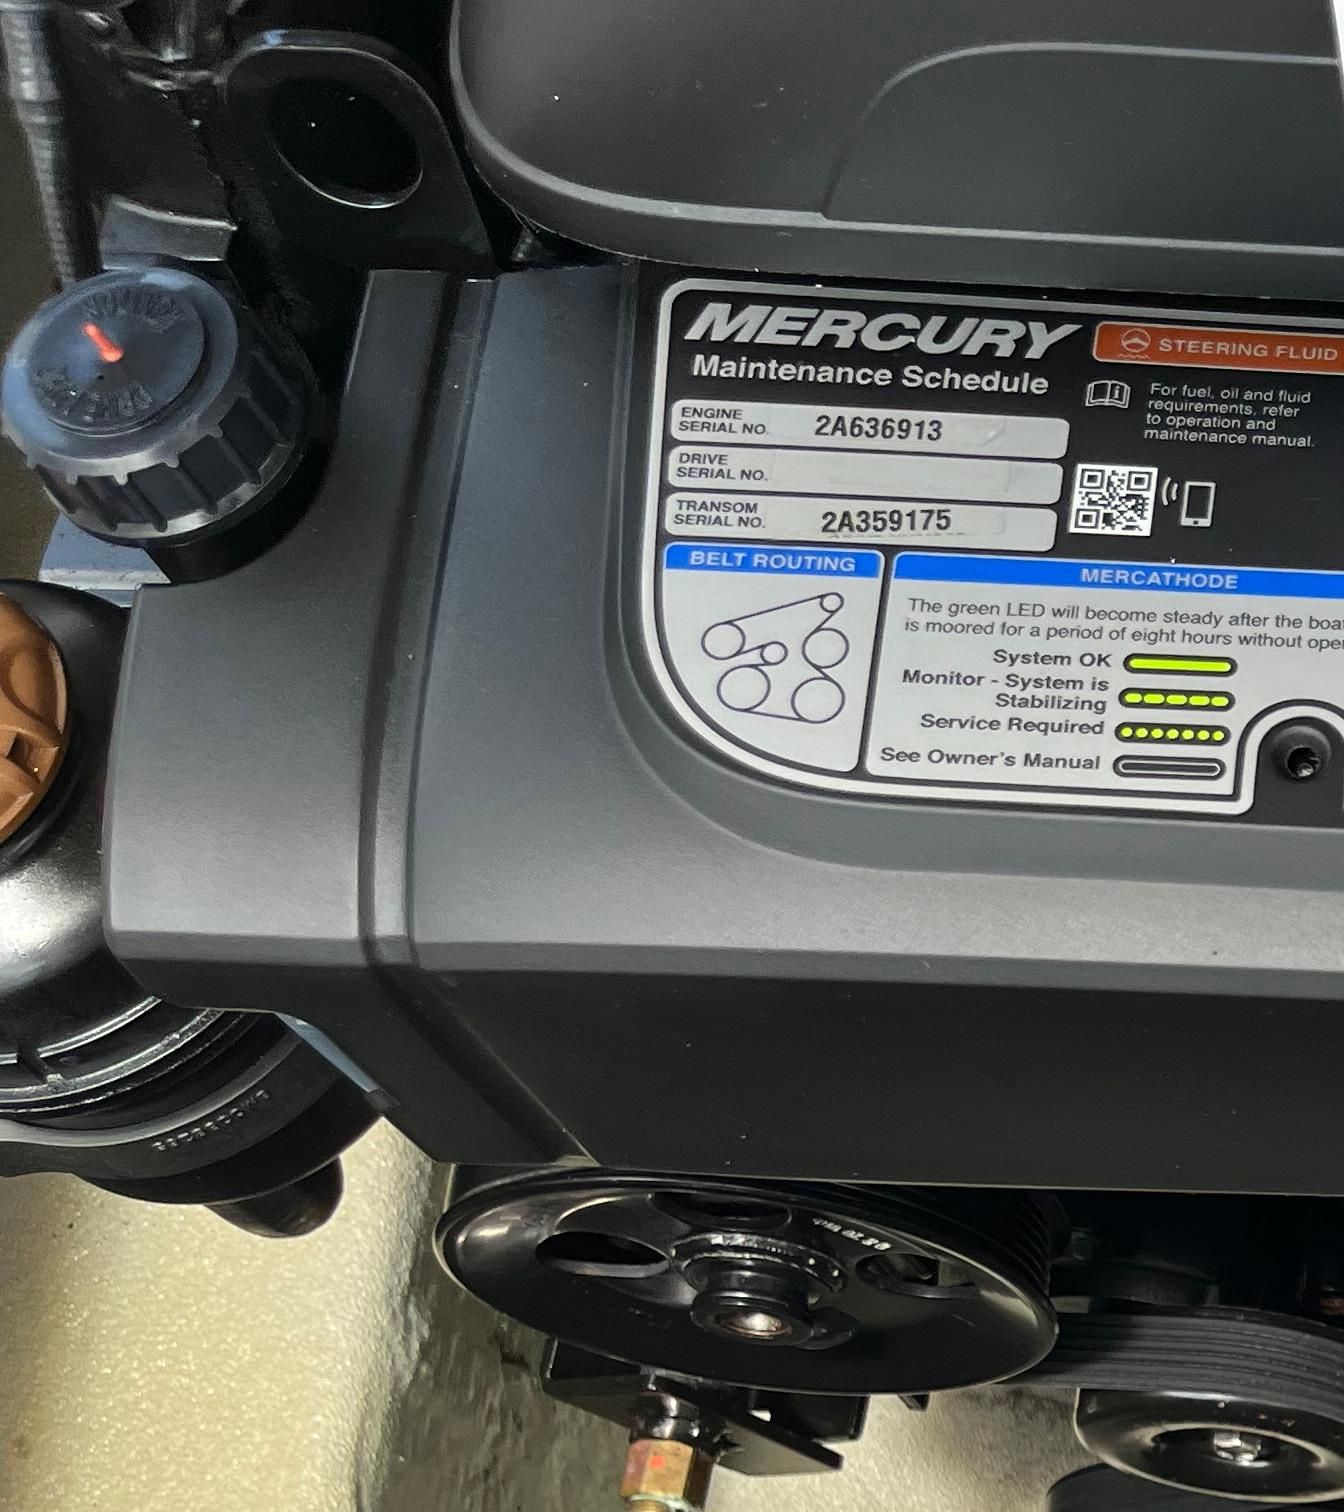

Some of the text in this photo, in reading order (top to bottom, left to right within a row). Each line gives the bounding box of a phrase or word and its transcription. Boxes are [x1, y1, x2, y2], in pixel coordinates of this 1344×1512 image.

[685, 302, 1083, 359] MERCURY
[1159, 338, 1338, 362] STEERING FLUID
[693, 354, 1048, 395] Maintenance Schedule
[1150, 383, 1311, 404] For fuel, oil and fluid
[681, 406, 743, 420] ENGINE
[1148, 398, 1300, 418] requirements, refer
[678, 420, 769, 435] SERIAL NO.
[814, 415, 943, 441] 2A636913
[1146, 413, 1276, 432] to operation and
[1144, 428, 1314, 448] maintenance manual.
[678, 452, 729, 465] DRIVE
[676, 466, 769, 481] SERIAL NO.
[677, 500, 758, 515] TRANSOM
[673, 513, 766, 529] SERIAL NO.
[821, 509, 952, 534] 2A359175
[689, 551, 856, 572] BELT ROUTING
[1081, 567, 1239, 589] MERCATHODE
[992, 649, 1112, 670] System OK
[995, 693, 1107, 715] Stabilizing
[920, 713, 1105, 738] Service Required
